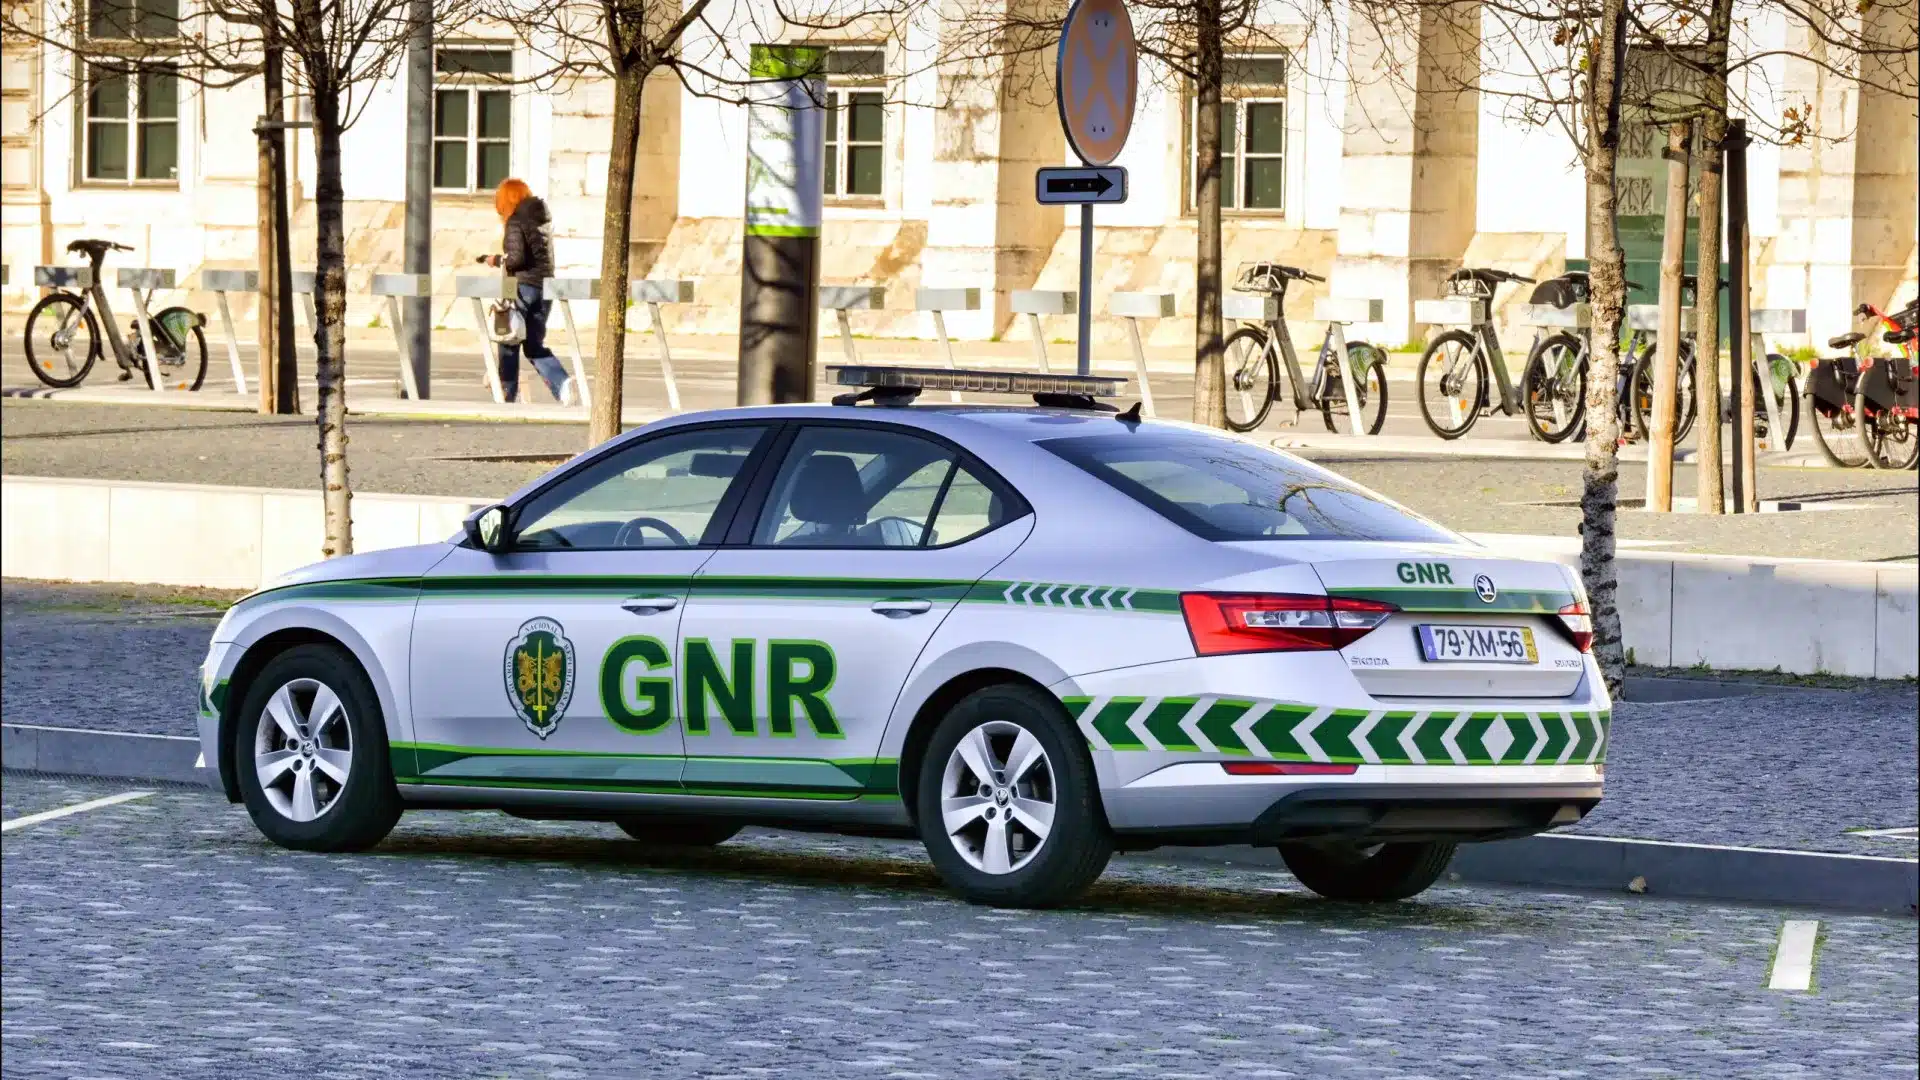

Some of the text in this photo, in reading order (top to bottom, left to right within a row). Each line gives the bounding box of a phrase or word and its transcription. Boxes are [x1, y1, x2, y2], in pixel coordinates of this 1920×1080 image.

[1397, 563, 1454, 584] GNR
[525, 622, 558, 633] NACIONAL
[599, 635, 846, 740] GNR
